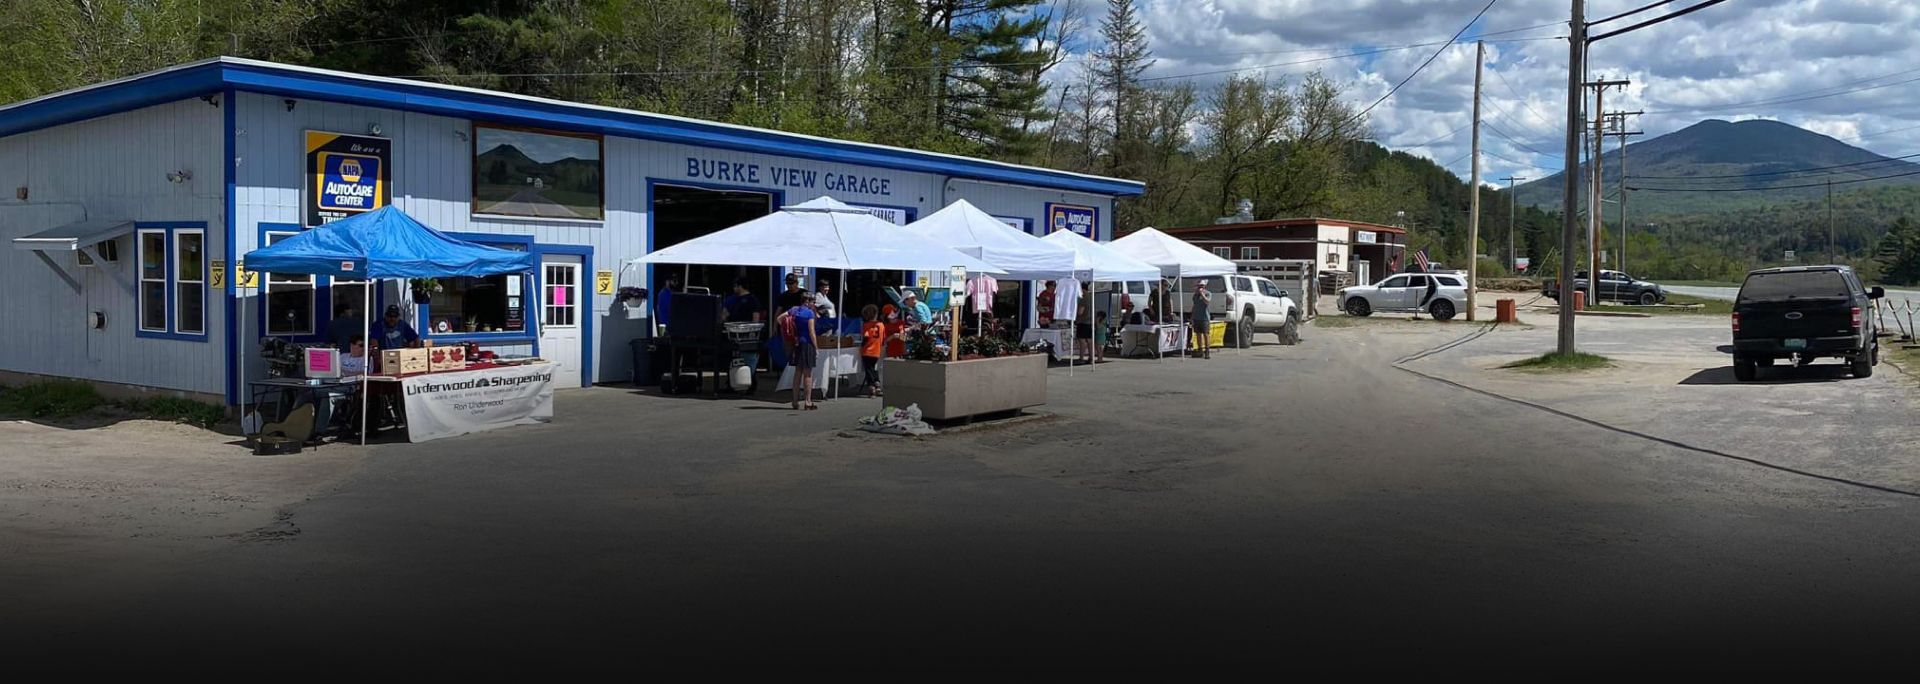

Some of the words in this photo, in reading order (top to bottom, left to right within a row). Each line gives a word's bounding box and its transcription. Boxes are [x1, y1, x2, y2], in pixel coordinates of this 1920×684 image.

[687, 157, 761, 184] BURKE
[770, 166, 817, 188] VIEW
[824, 172, 891, 196] GARAGE
[335, 195, 363, 206] CENTER
[406, 379, 474, 396] Underwood
[491, 372, 552, 387] Sharpening
[453, 403, 467, 411] Ron
[468, 399, 504, 410] Underwood
